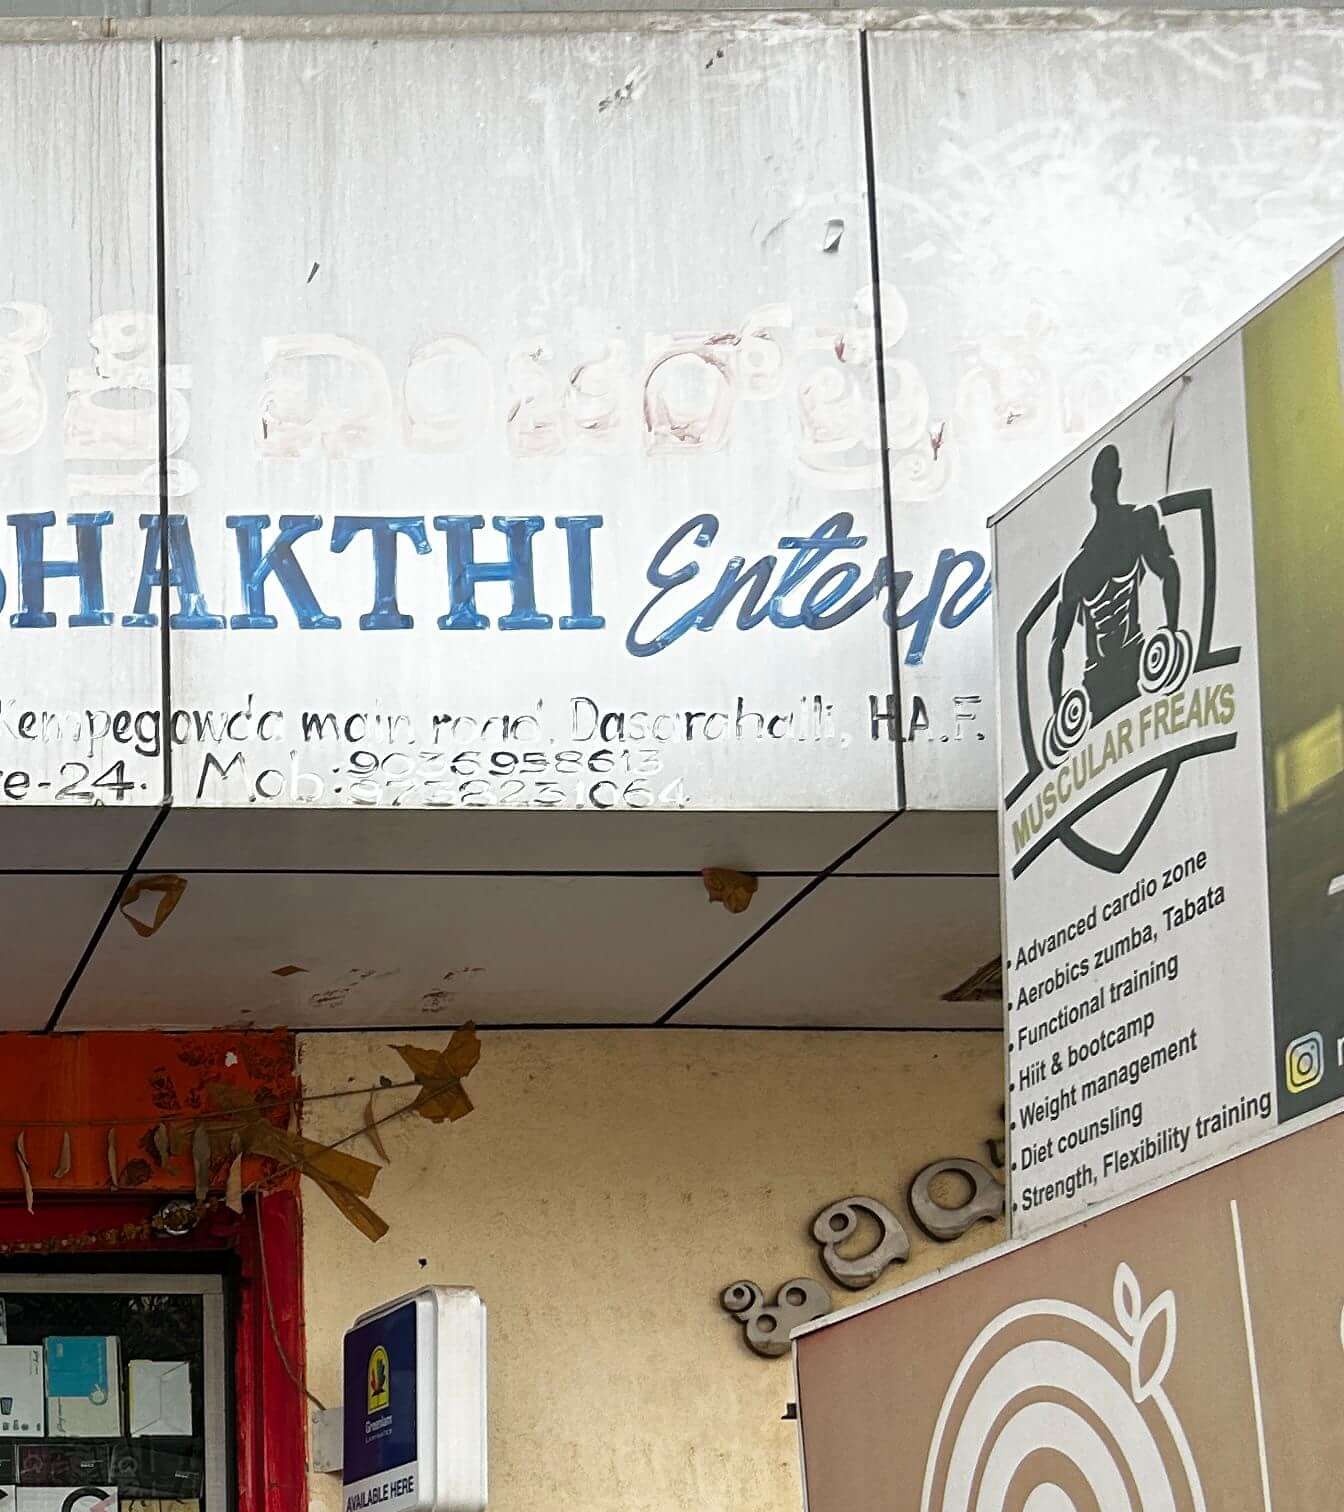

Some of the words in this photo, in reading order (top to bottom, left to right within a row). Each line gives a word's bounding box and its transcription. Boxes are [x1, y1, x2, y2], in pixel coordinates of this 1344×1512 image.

[1012, 718, 1134, 852] MUSCULAR
[1139, 683, 1236, 748] FREAKS
[1015, 905, 1097, 970] Advanced
[1102, 879, 1157, 922] cardio
[1162, 850, 1207, 890] zone
[1017, 957, 1089, 1010] Aerobics
[1094, 923, 1158, 970] zumba,
[1162, 886, 1225, 931] Tabata
[1018, 988, 1105, 1051] Functional
[1110, 954, 1179, 1004] training
[1019, 1062, 1046, 1092] Hiit
[1051, 1052, 1063, 1075] &
[1068, 1010, 1155, 1068] bootcamp
[1019, 1085, 1076, 1130] Weight
[1082, 1027, 1198, 1101] management
[1020, 1138, 1053, 1171] Diet
[1057, 1101, 1143, 1151] counsling
[1021, 1162, 1098, 1211] Strength,
[1103, 1124, 1190, 1178] Flexibility
[1196, 1091, 1272, 1139] training
[346, 1484, 388, 1512] AVAILABLE
[390, 1476, 414, 1499] HERE
